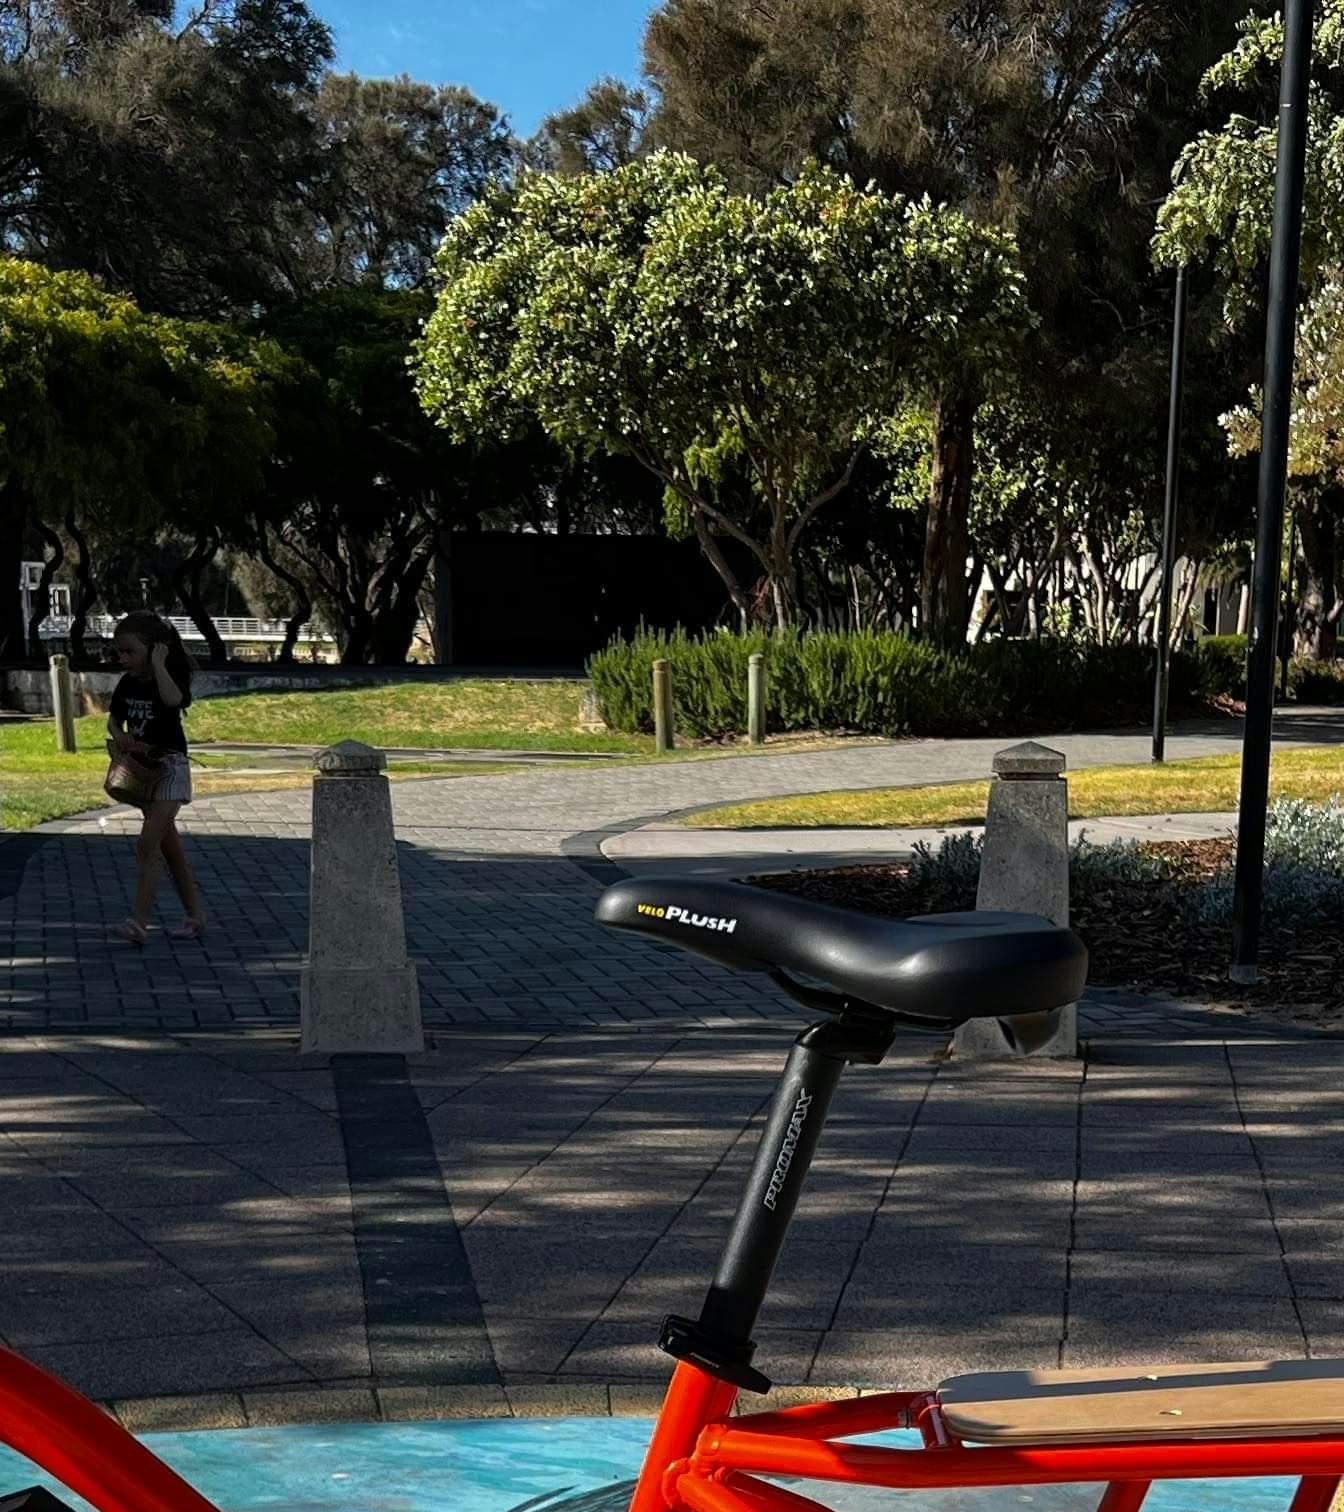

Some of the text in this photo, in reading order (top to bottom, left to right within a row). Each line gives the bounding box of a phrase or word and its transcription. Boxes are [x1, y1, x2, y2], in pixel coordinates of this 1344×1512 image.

[637, 903, 737, 933] VELO PLUSH
[763, 1089, 813, 1211] PROMAX
